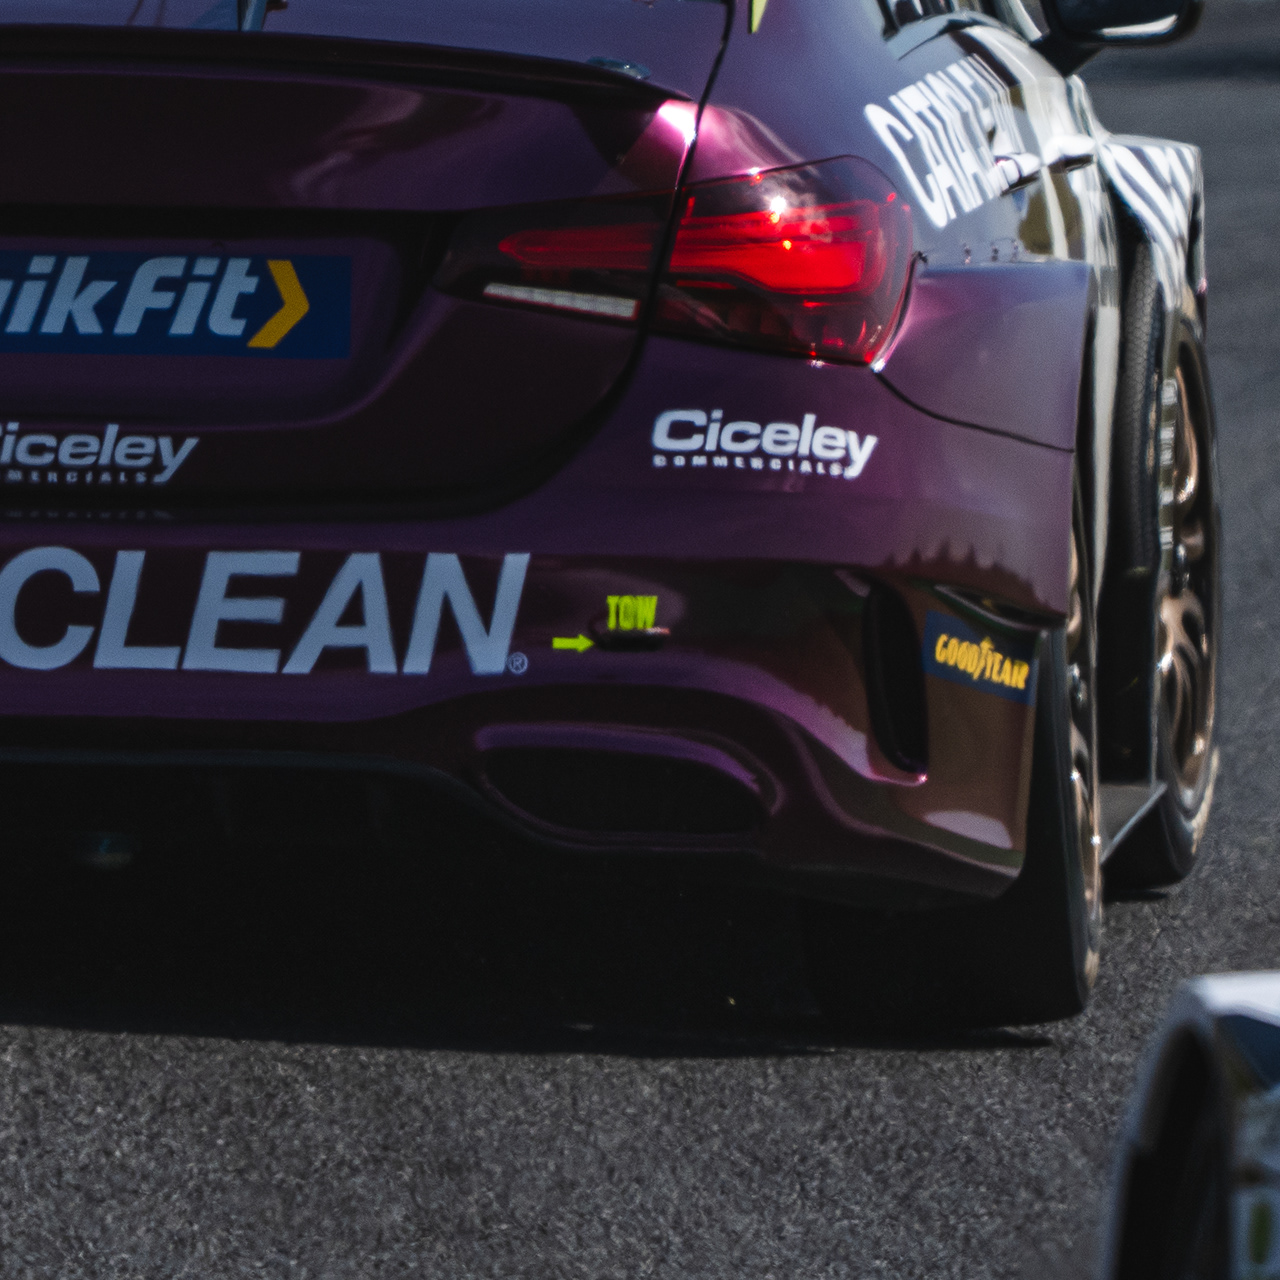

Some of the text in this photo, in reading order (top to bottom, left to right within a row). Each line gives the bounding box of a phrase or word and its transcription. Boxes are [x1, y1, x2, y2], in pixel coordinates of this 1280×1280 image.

[652, 409, 879, 480] Ciceley
[606, 595, 658, 631] TOW
[934, 633, 1030, 690] GOODYEAR
